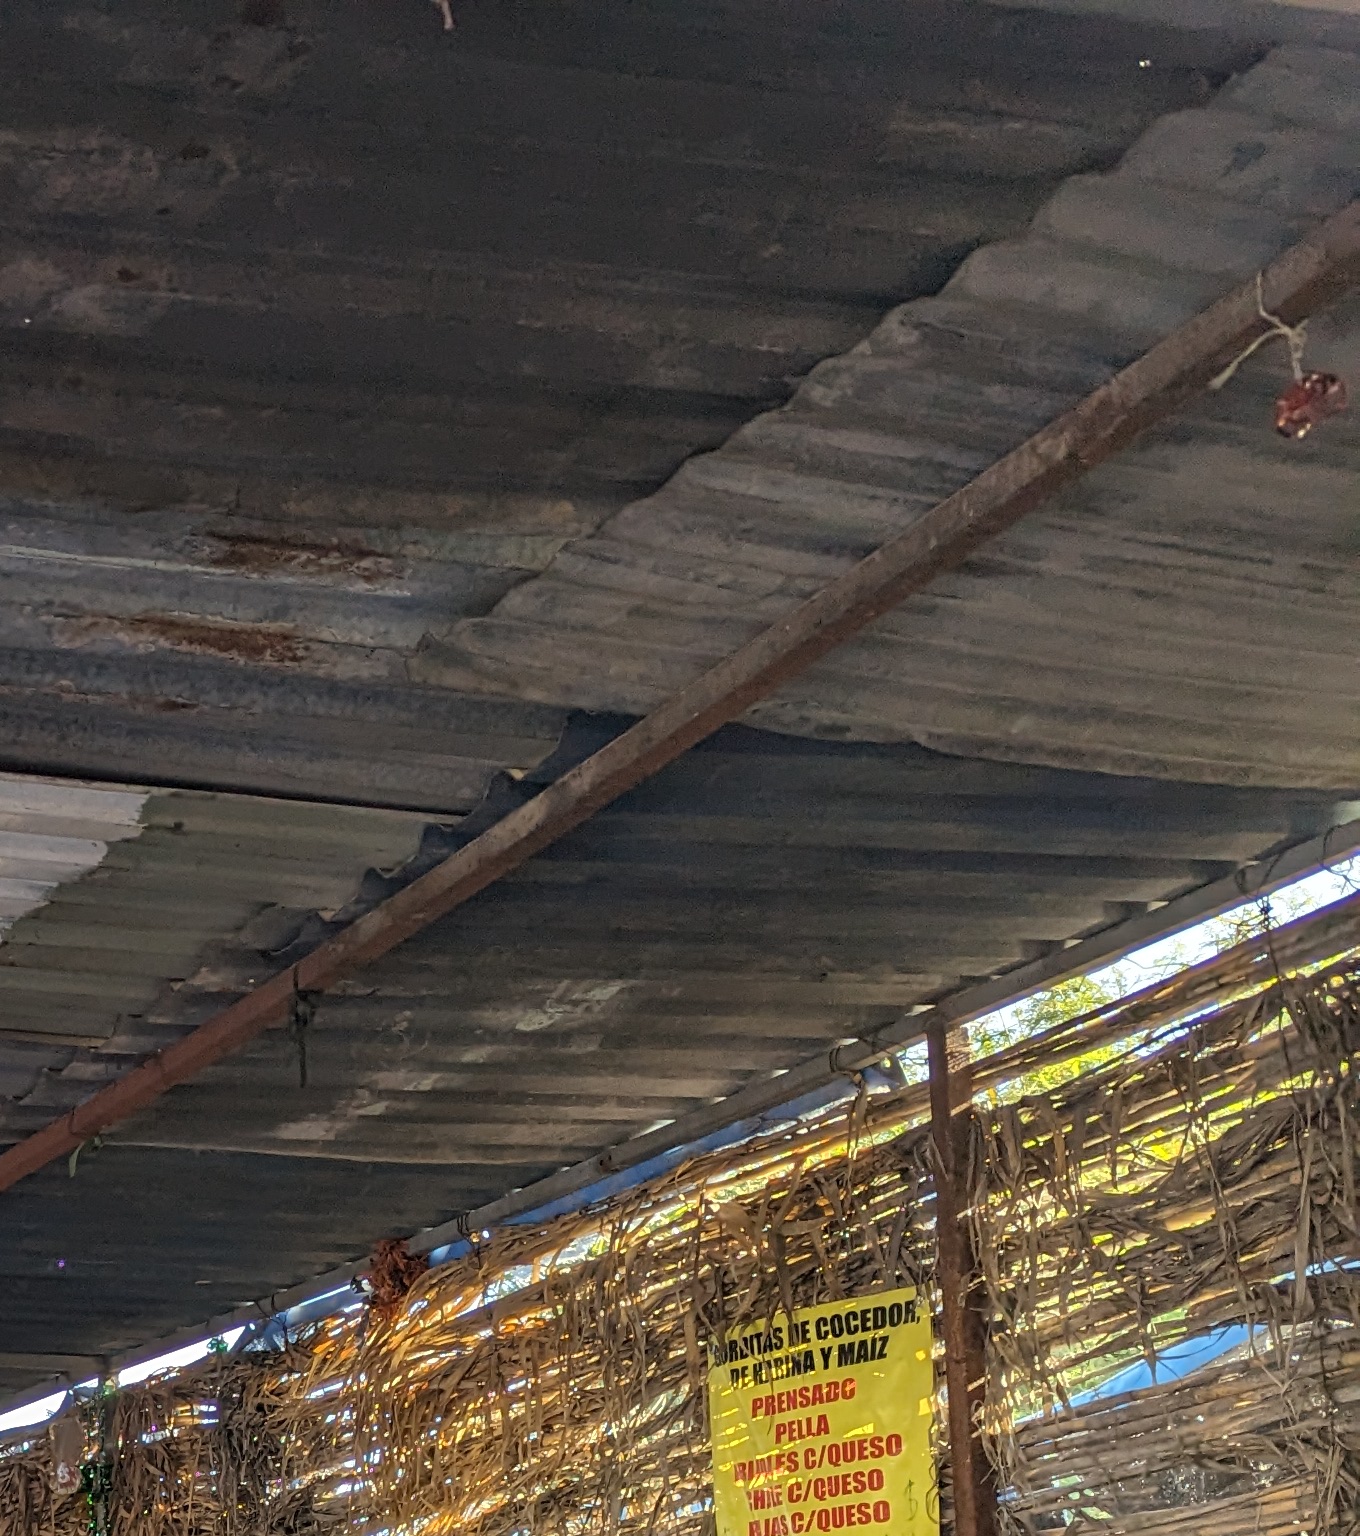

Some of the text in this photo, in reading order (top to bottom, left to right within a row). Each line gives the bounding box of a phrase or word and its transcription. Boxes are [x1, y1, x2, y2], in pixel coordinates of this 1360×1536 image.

[788, 1320, 811, 1348] DE
[815, 1300, 920, 1341] COCEDOR,
[820, 1346, 833, 1371] Y
[837, 1334, 890, 1367] MAÍZ
[751, 1378, 857, 1418] PRENSADO
[775, 1414, 830, 1444] PELLA
[803, 1433, 902, 1470] C/QUESO
[787, 1468, 884, 1504] C/QUESO
[790, 1500, 890, 1534] C/QUESO
